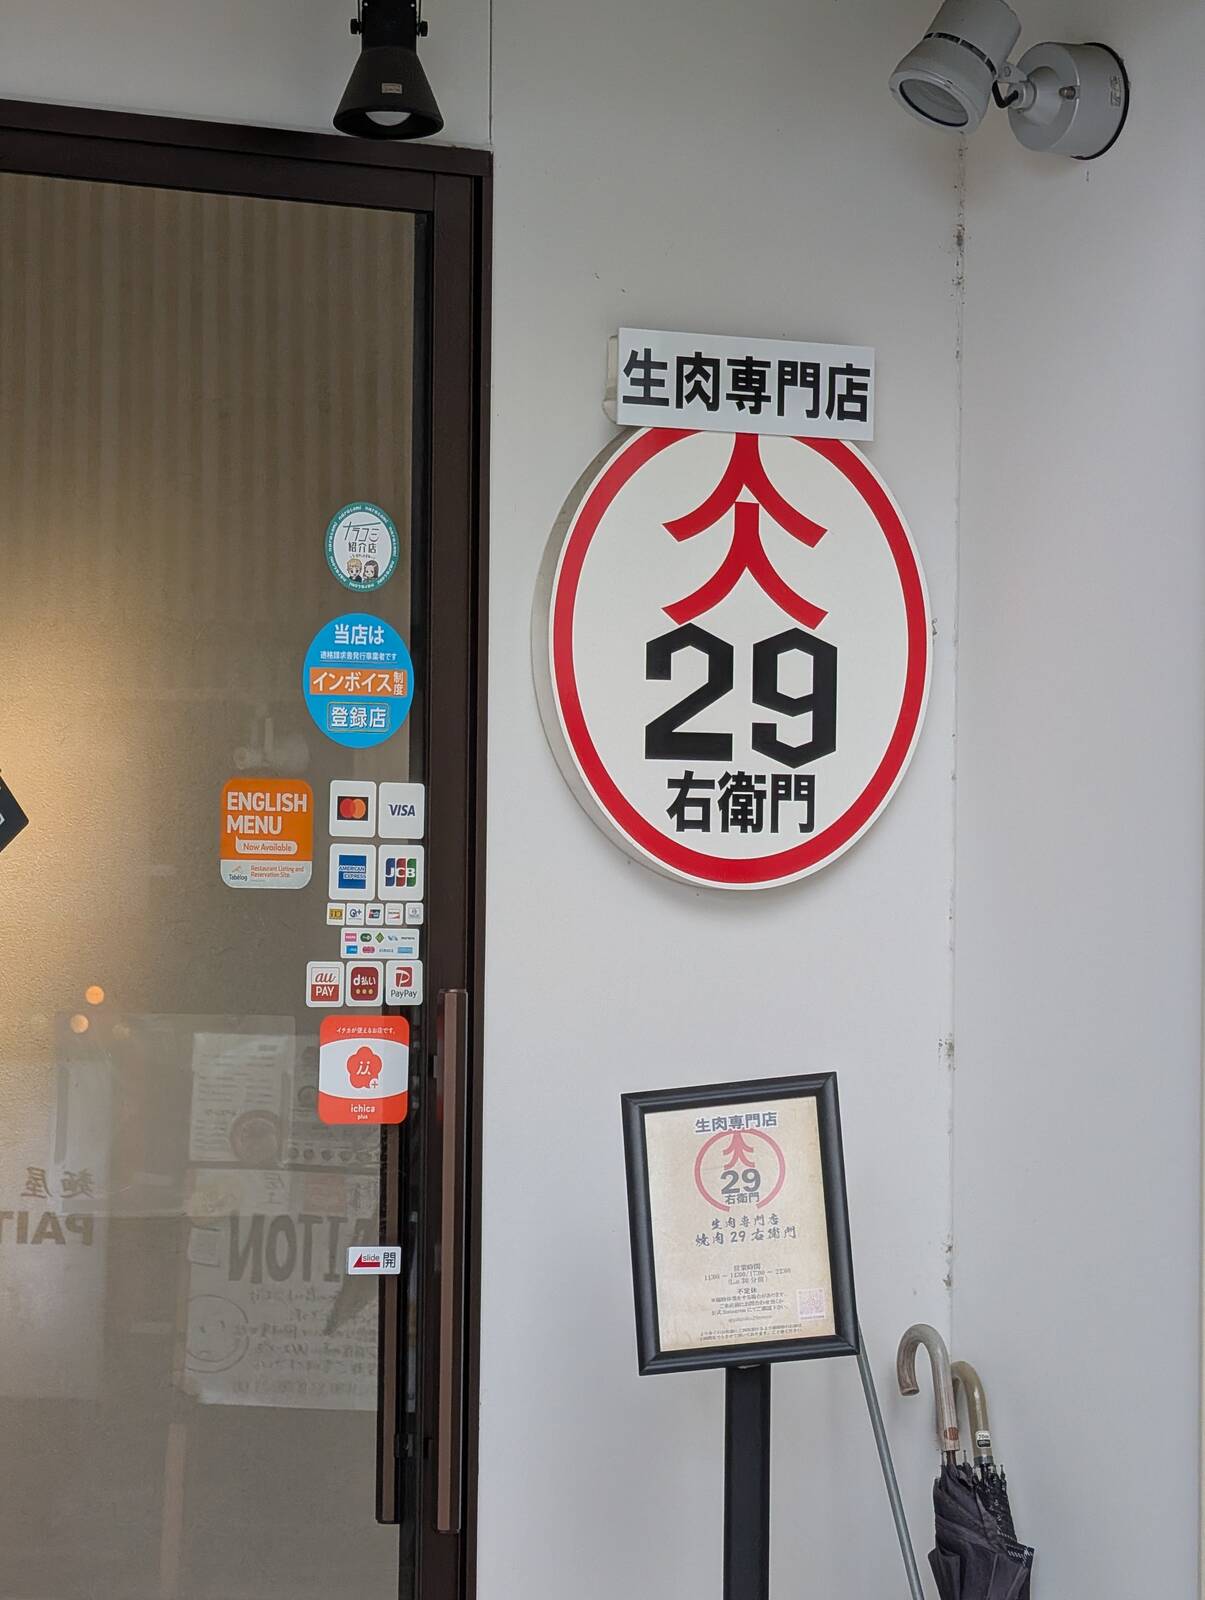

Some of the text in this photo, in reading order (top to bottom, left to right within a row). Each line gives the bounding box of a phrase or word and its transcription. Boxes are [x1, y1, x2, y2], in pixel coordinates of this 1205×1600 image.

[622, 348, 871, 422] 生肉専門店
[348, 542, 376, 553] 紹介店
[334, 624, 384, 645] 当店は
[313, 671, 404, 696] インボイス 制度
[645, 623, 837, 769] 29
[331, 706, 386, 728] 登録店
[227, 791, 307, 812] ENGLISH
[667, 769, 815, 833] 右衛門
[389, 804, 415, 816] VISA
[227, 815, 282, 835] MENU
[243, 843, 292, 852] Now Available
[315, 972, 336, 983] au
[353, 974, 376, 986] d払い
[315, 986, 335, 997] PAY
[390, 989, 418, 999] PayPay
[350, 1104, 376, 1113] ichica
[695, 1112, 777, 1133] 生肉専門店
[720, 1168, 761, 1194] 29
[725, 1192, 759, 1205] 右衛門
[712, 1213, 779, 1230] 生肉専門店
[362, 1252, 396, 1268] slide 開
